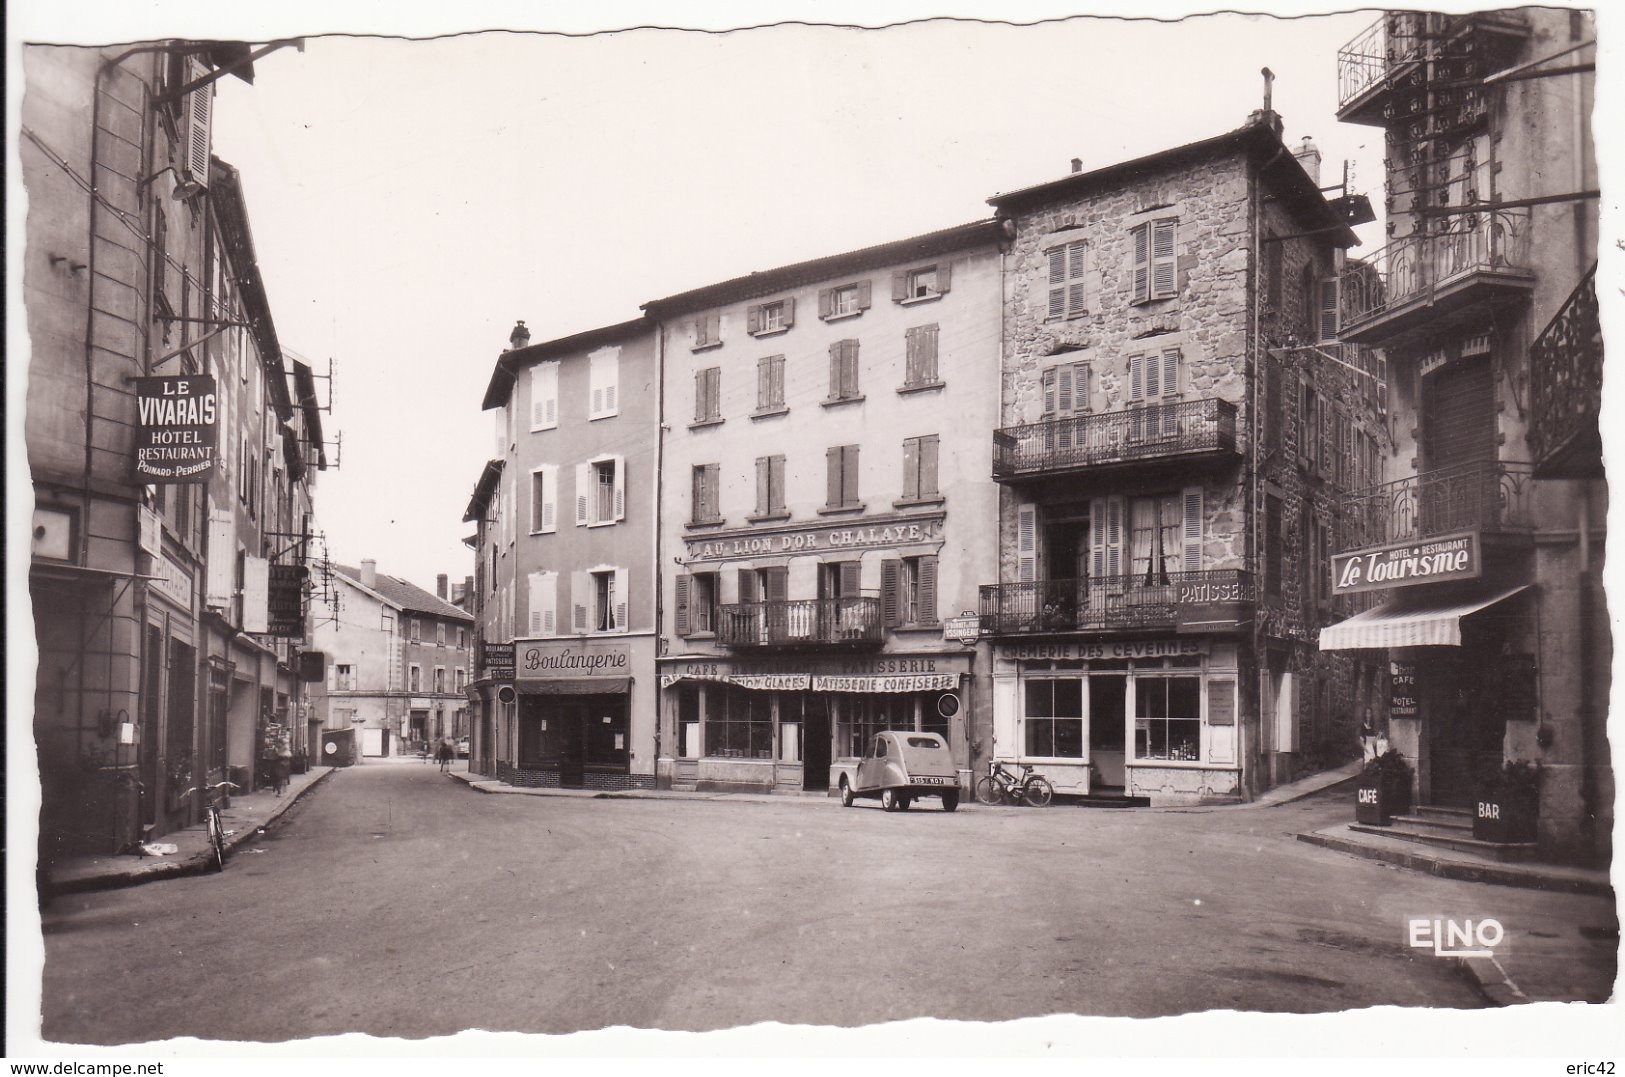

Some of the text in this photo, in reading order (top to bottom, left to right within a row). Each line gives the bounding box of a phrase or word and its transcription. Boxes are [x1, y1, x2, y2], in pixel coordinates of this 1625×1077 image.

[163, 381, 189, 395] LE
[138, 394, 216, 426] VIVARAIS
[138, 447, 213, 460] RESTAURANT
[703, 543, 724, 557] AU
[734, 538, 772, 554] LION
[829, 524, 920, 546] CHALAYE
[1389, 539, 1469, 561] HOTEL RESTAURANT
[1337, 550, 1469, 588] Le Tourisme
[525, 648, 627, 675] Boulangerie
[1078, 643, 1104, 658] DES
[1478, 801, 1500, 820] BAR
